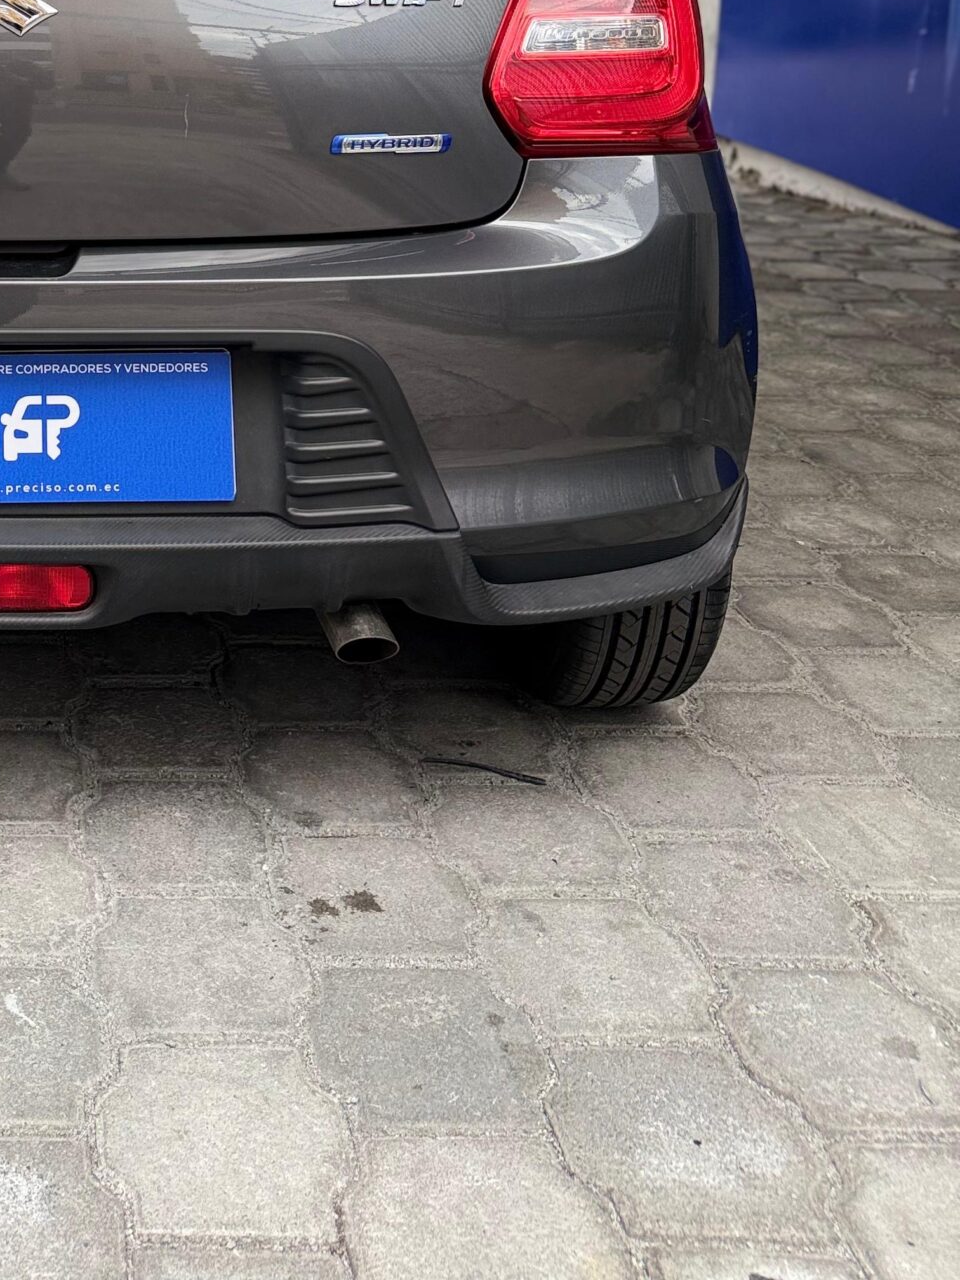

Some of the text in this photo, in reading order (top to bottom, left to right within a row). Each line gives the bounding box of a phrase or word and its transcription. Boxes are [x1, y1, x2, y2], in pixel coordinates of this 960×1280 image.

[349, 135, 435, 150] HYBRID
[15, 364, 111, 374] COMPRADORES
[113, 363, 122, 373] Y
[124, 362, 208, 373] VENDEDORES
